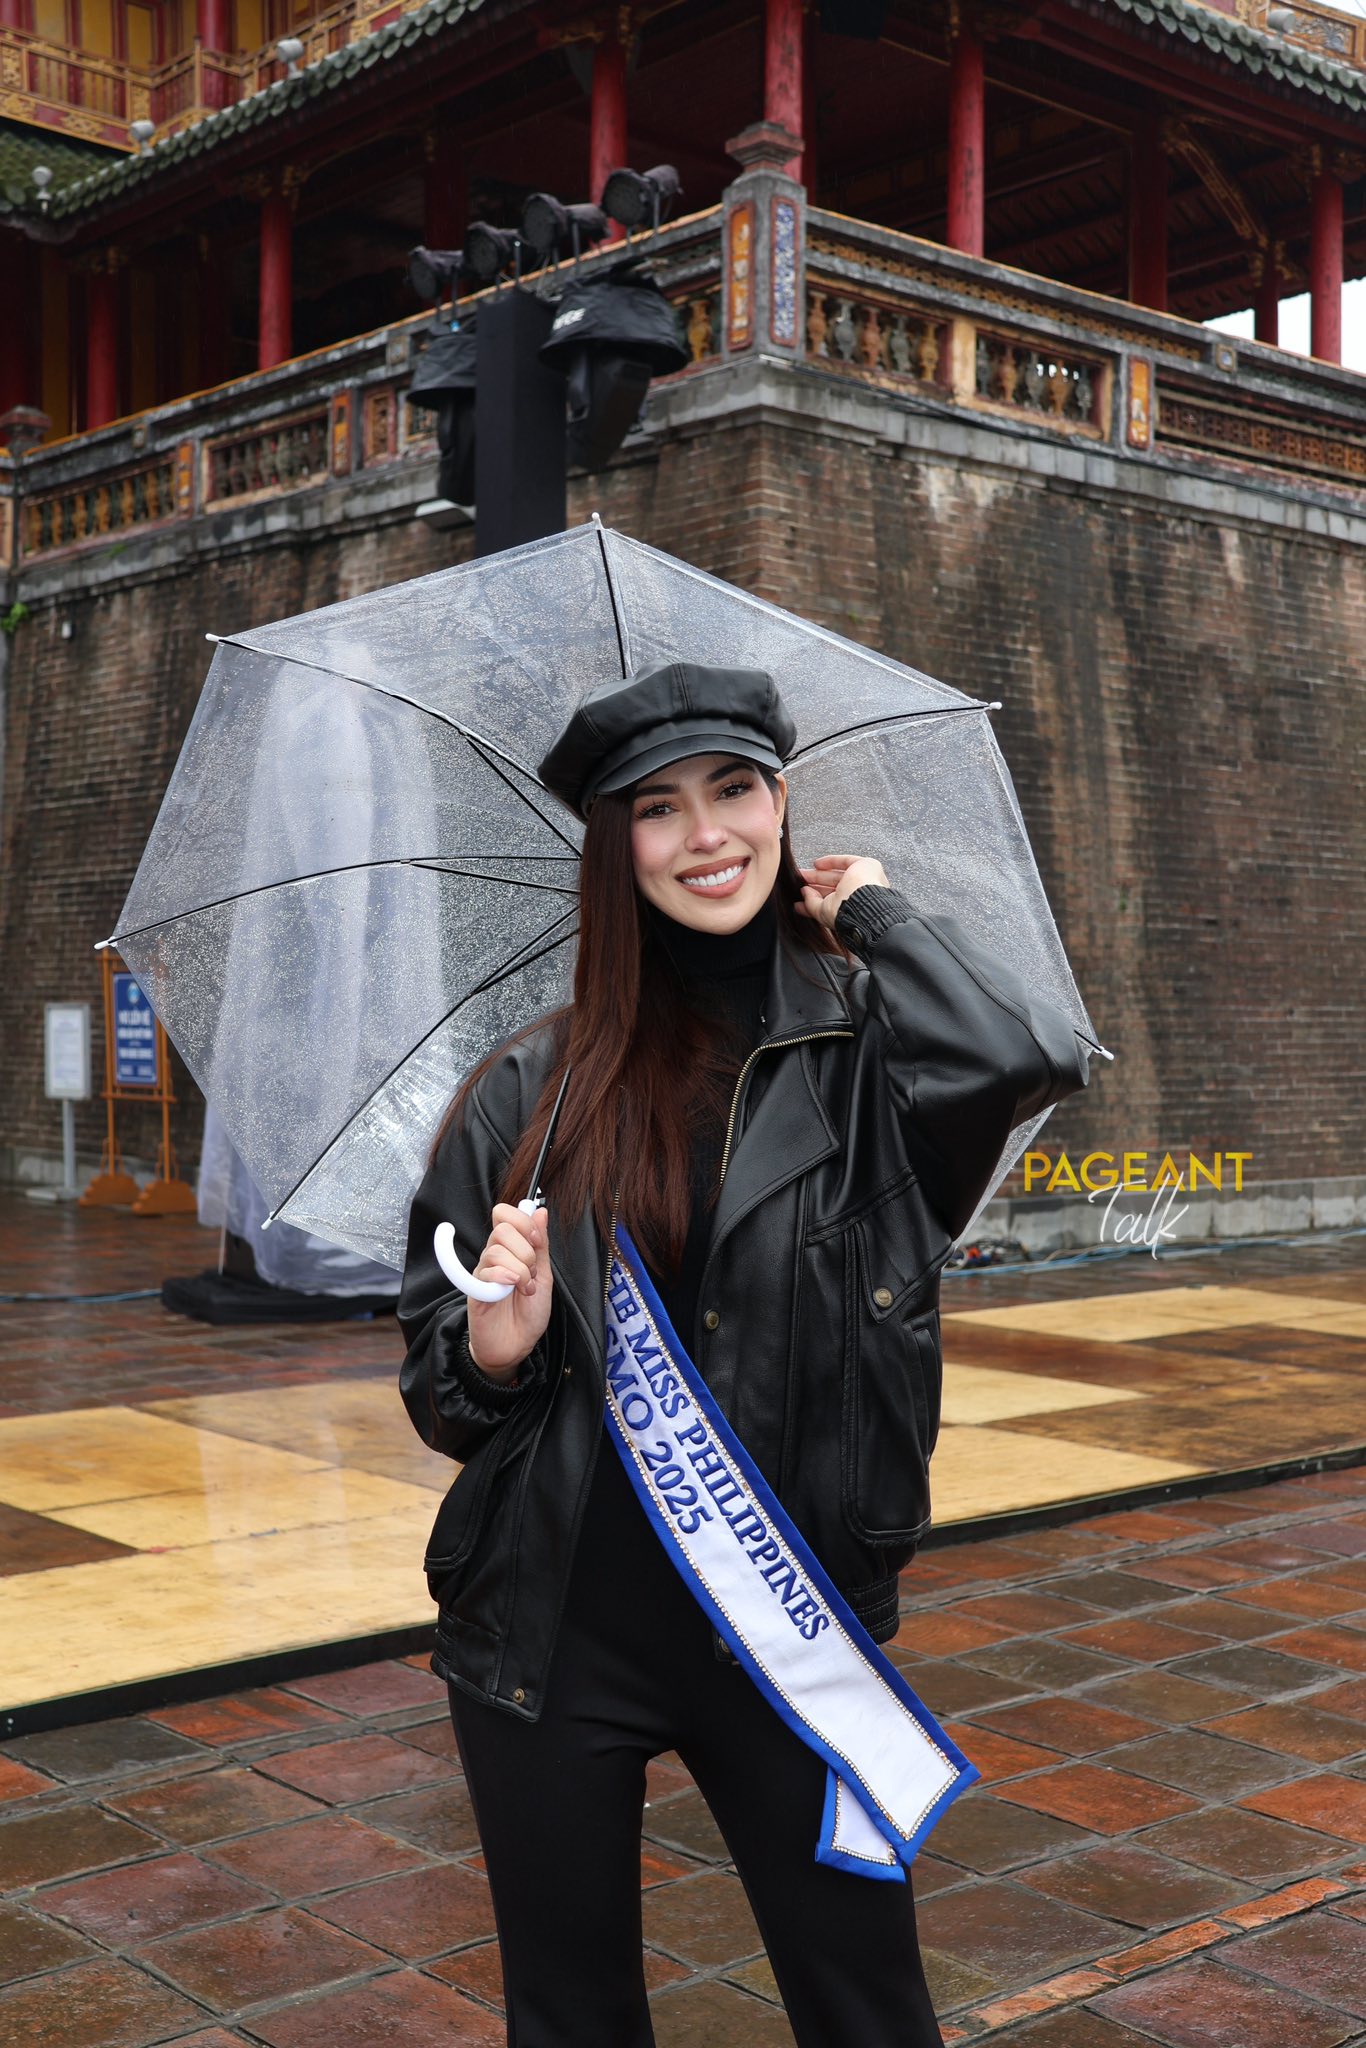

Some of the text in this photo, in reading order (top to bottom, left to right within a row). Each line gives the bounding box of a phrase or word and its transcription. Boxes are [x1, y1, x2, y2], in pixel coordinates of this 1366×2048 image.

[625, 1324, 690, 1418] MISS
[674, 1418, 830, 1640] PHILIPPINES
[640, 1440, 714, 1535] 2025
